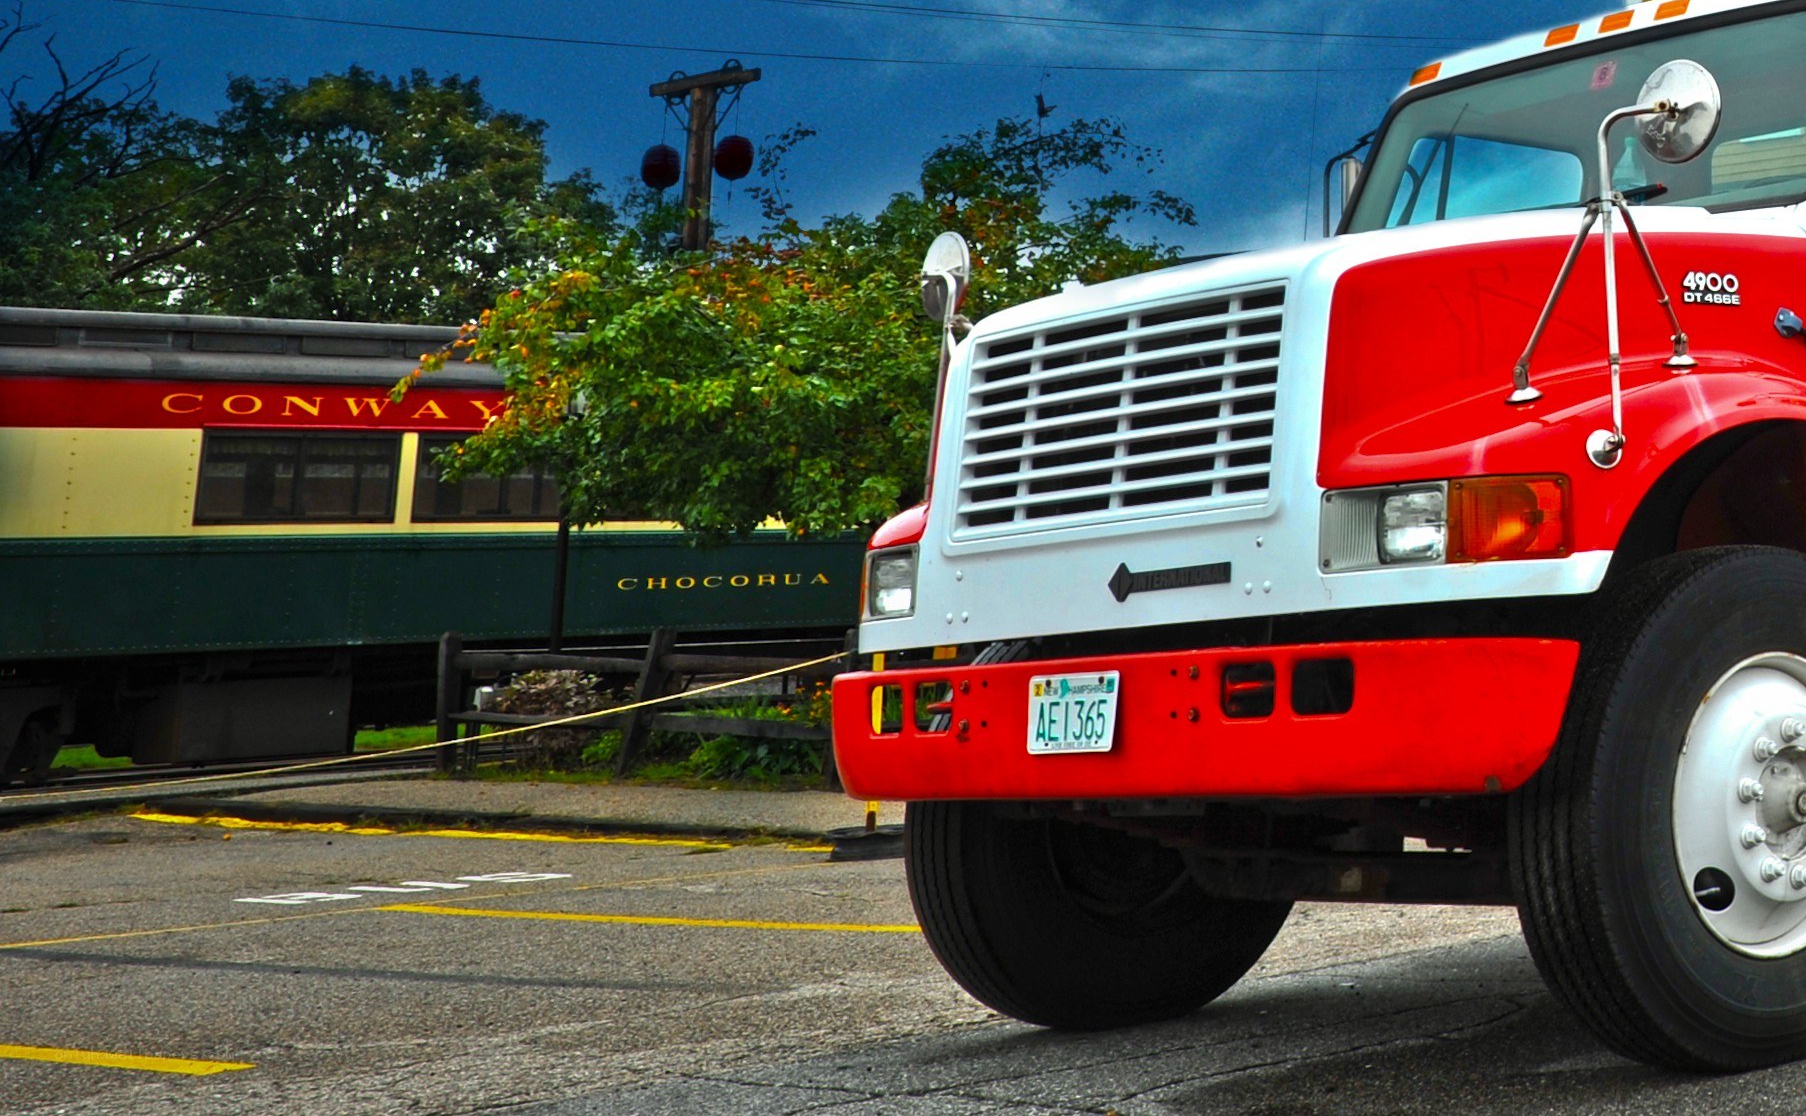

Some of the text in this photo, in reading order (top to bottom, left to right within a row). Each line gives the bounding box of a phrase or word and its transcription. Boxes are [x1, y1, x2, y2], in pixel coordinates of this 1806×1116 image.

[1683, 272, 1739, 292] 4900
[1684, 292, 1740, 305] DT 466E
[161, 393, 503, 421] CONWAY
[617, 572, 830, 591] CHOCORUA
[233, 872, 572, 905] BUS
